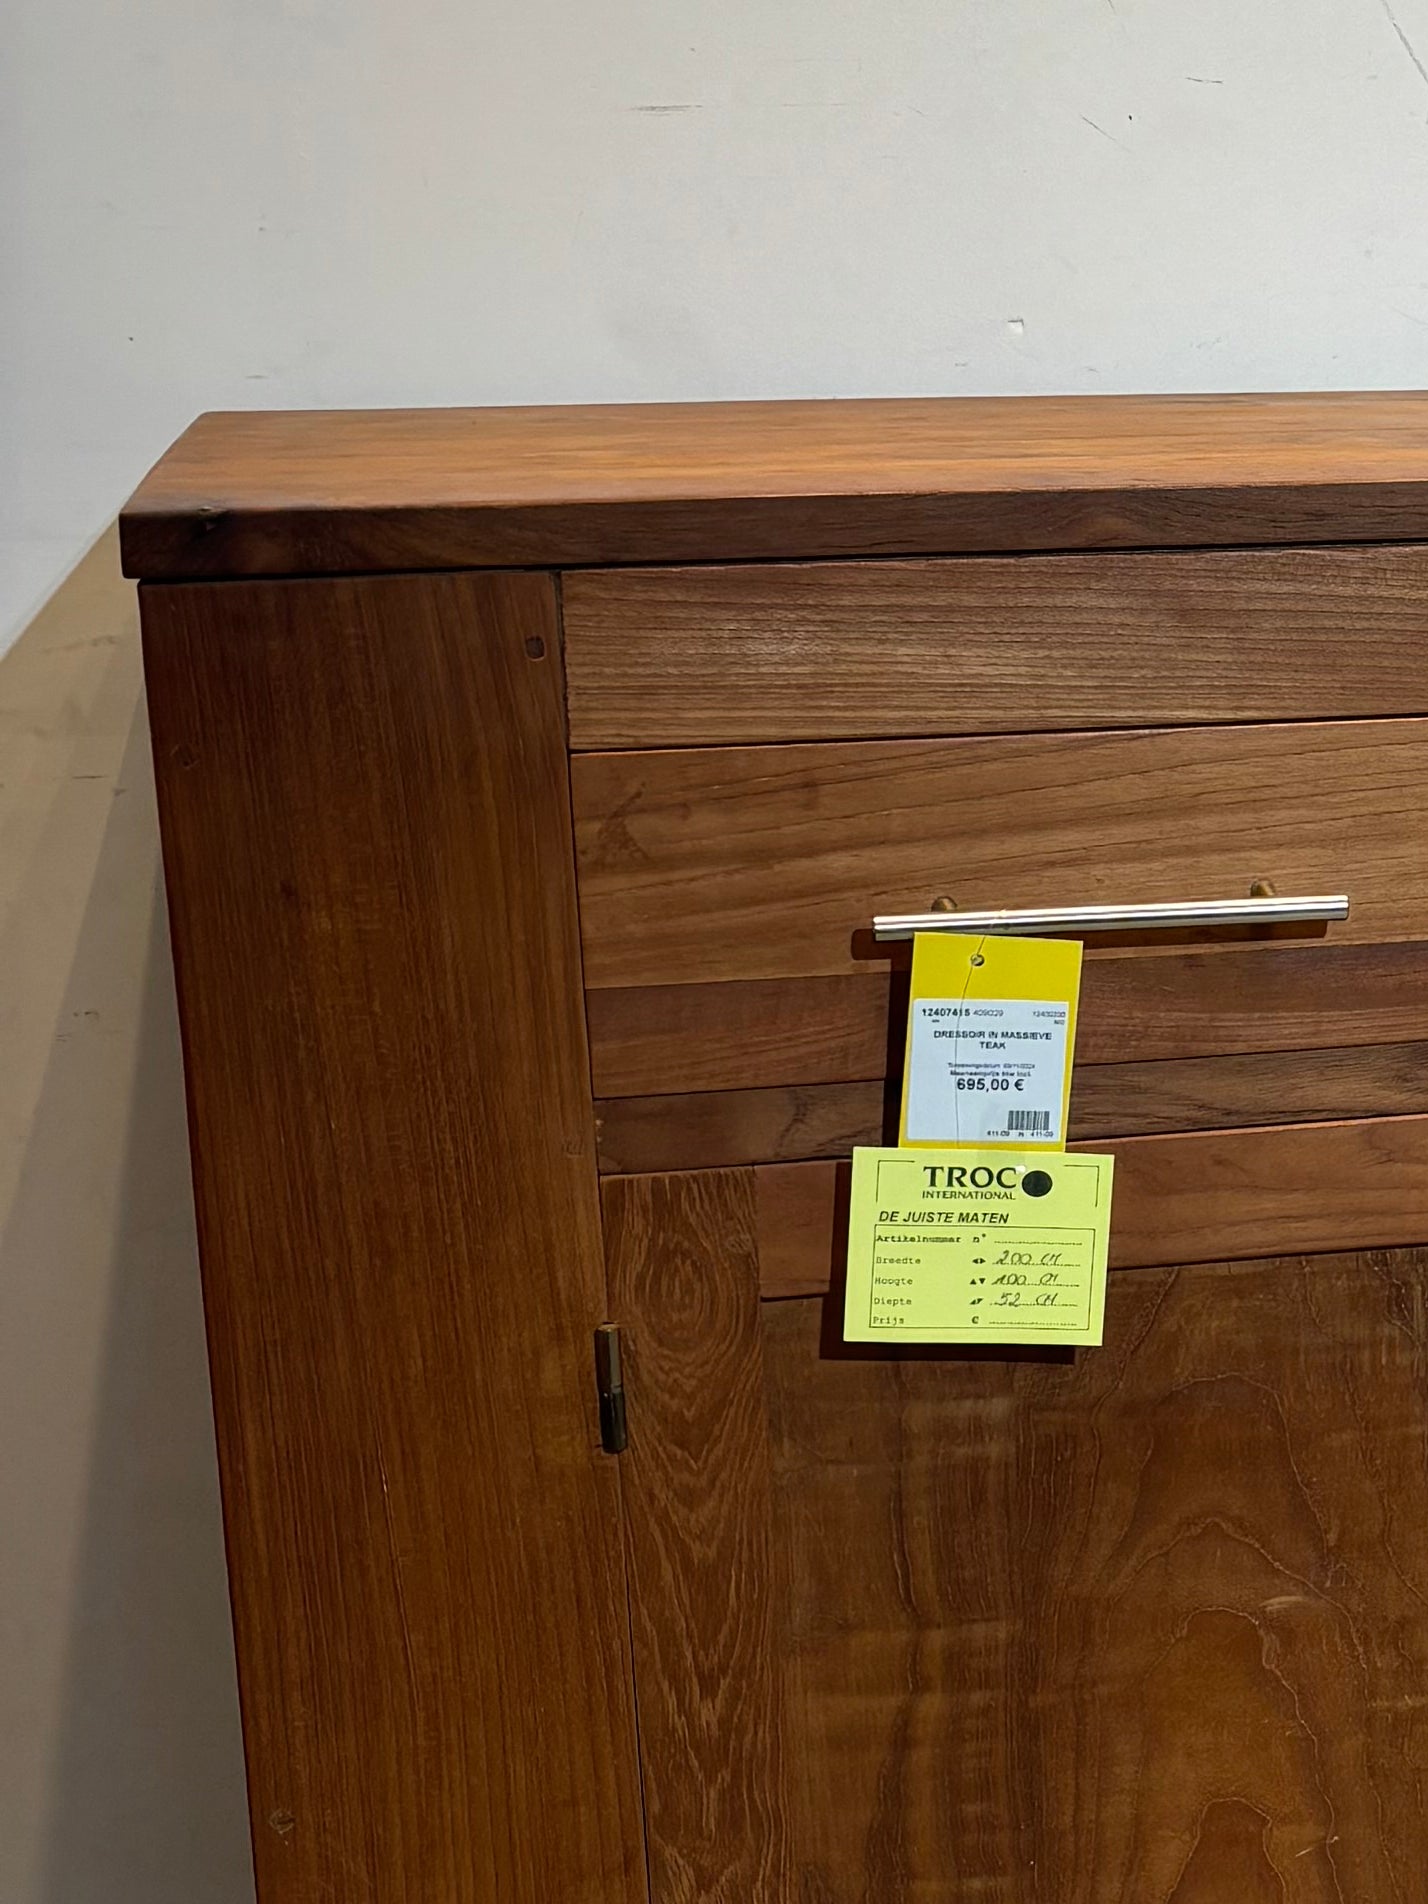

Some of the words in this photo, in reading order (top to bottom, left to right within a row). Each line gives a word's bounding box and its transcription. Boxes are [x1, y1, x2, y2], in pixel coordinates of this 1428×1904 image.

[933, 1030, 986, 1039] DRESSOIR
[1001, 1031, 1053, 1040] MASSIEVE
[980, 1041, 1006, 1049] TEAK
[957, 1077, 1010, 1093] 695,00
[1014, 1079, 1025, 1091] €
[923, 1165, 1018, 1188] TROC
[922, 1190, 1016, 1201] INTERNATIONAL
[878, 1210, 900, 1222] DE
[902, 1211, 955, 1223] JUISTE
[957, 1212, 1010, 1224] MATEN
[876, 1256, 921, 1265] Breedte
[874, 1276, 914, 1287] Hoogte
[873, 1297, 913, 1307] Diepte
[873, 1316, 905, 1326] Prijs
